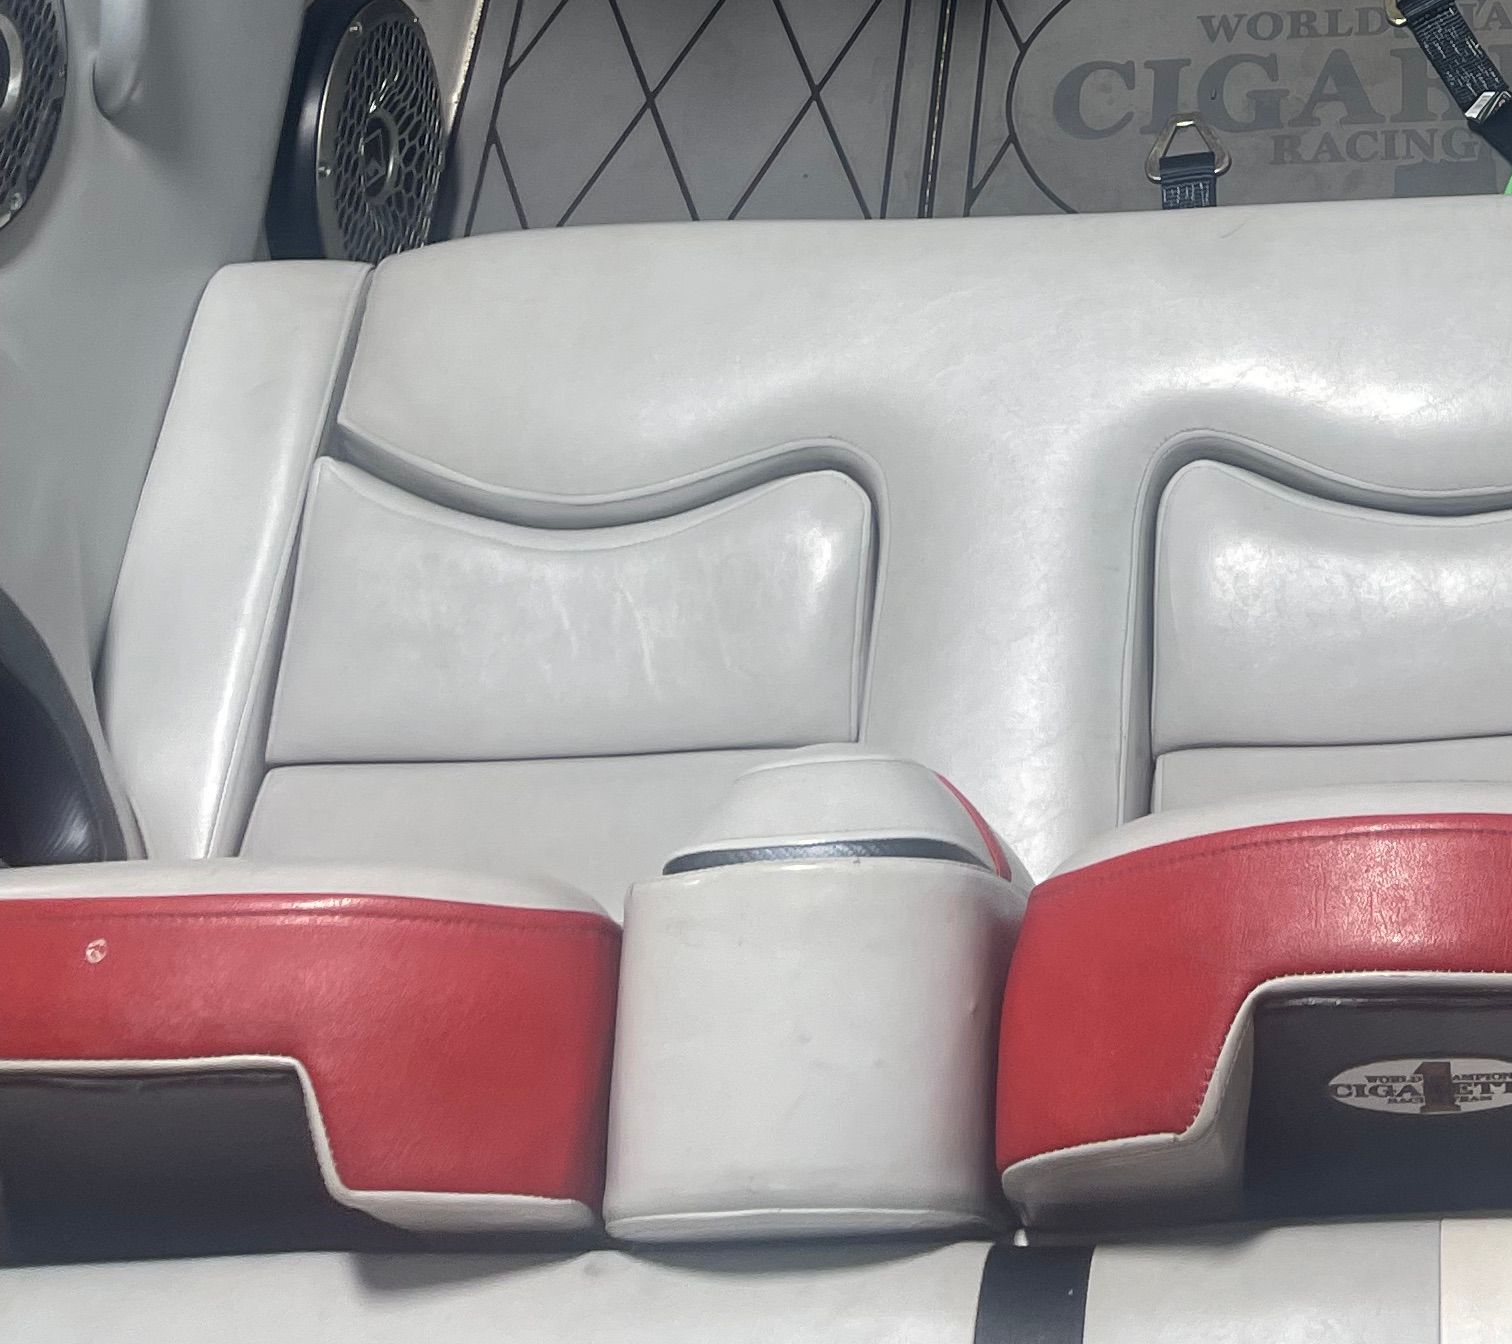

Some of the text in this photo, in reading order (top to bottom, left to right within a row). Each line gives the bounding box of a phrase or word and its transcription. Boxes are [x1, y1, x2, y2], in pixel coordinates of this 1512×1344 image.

[1197, 2, 1390, 45] WORLD
[1272, 123, 1480, 167] RACING
[1365, 1075, 1423, 1084] WORLD
